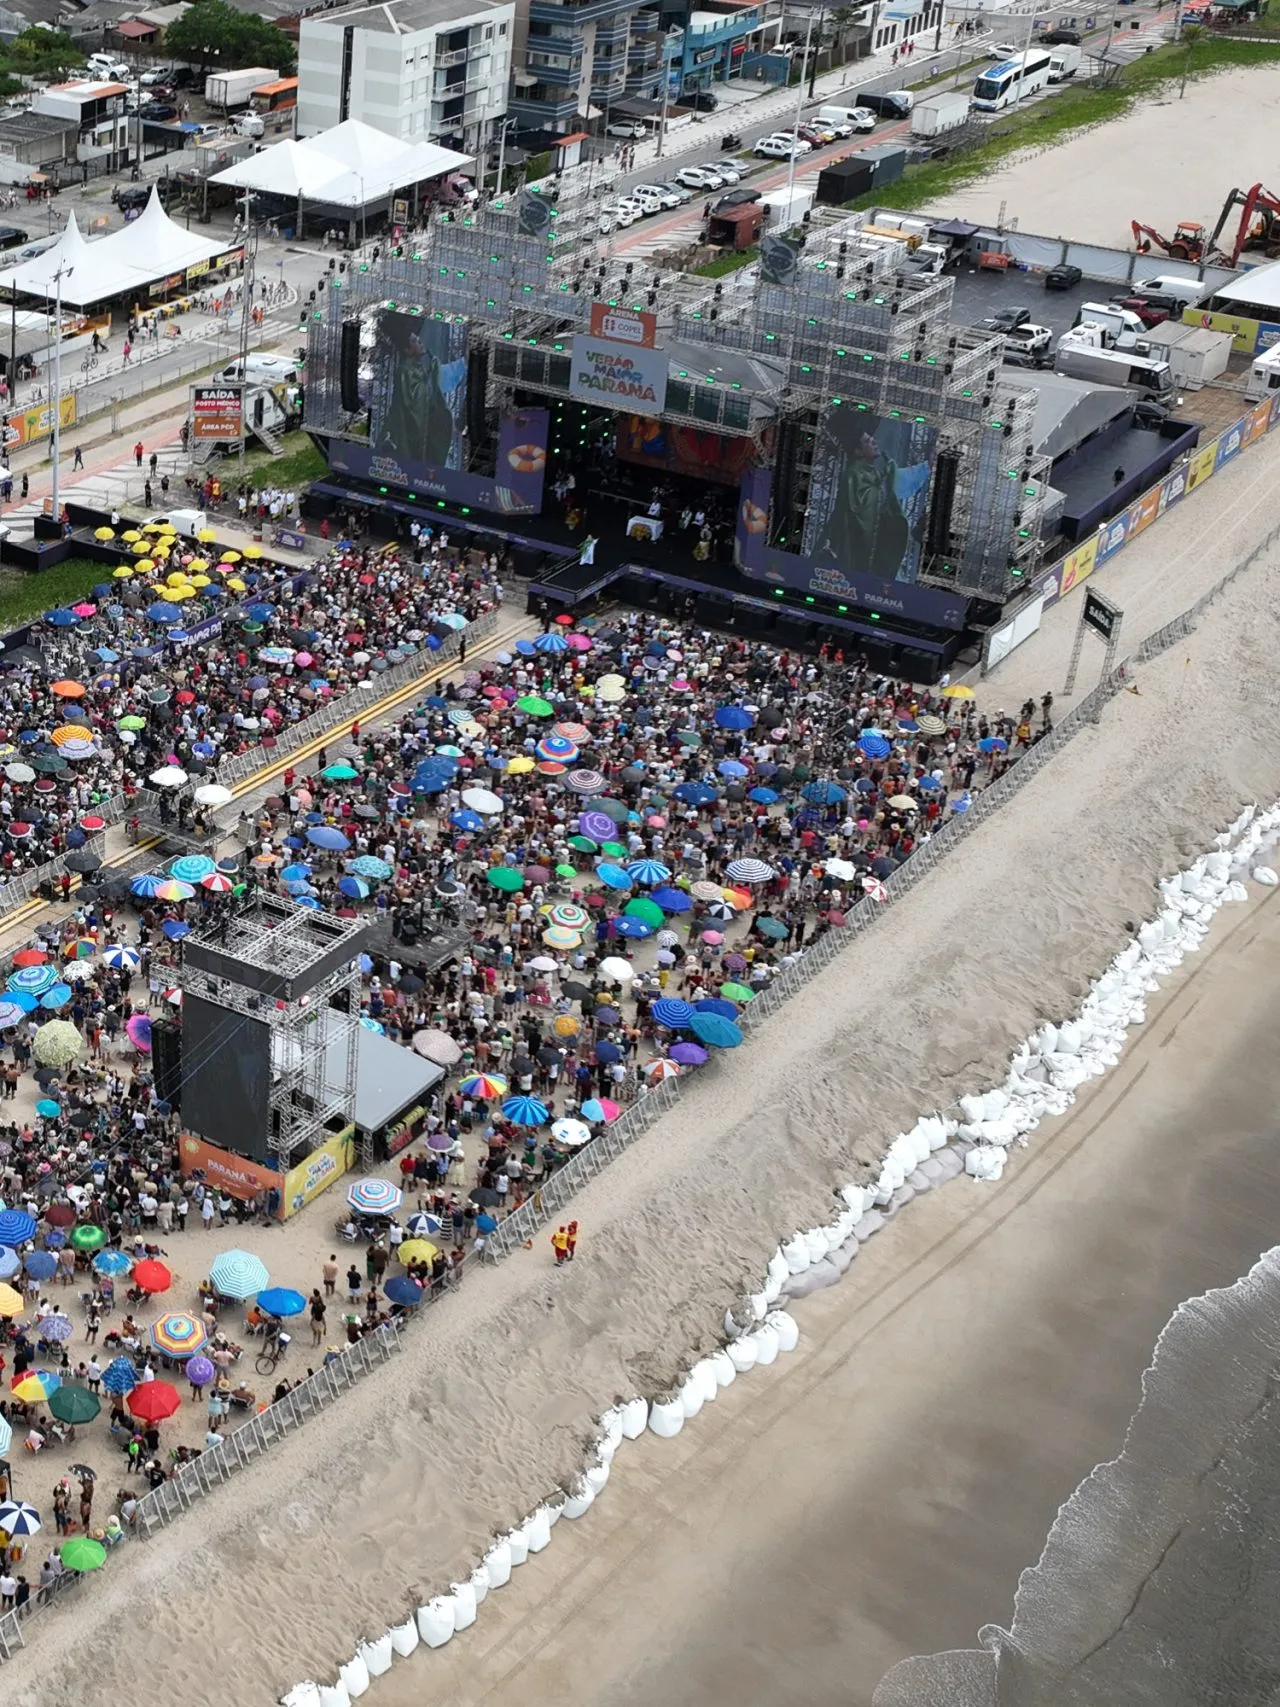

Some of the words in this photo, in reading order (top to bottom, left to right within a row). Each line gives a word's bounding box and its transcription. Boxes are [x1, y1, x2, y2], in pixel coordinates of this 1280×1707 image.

[586, 351, 634, 369] VERÃO
[594, 364, 644, 384] MAIOR
[201, 389, 235, 400] SAÍDA
[578, 371, 657, 402] PARANÁ
